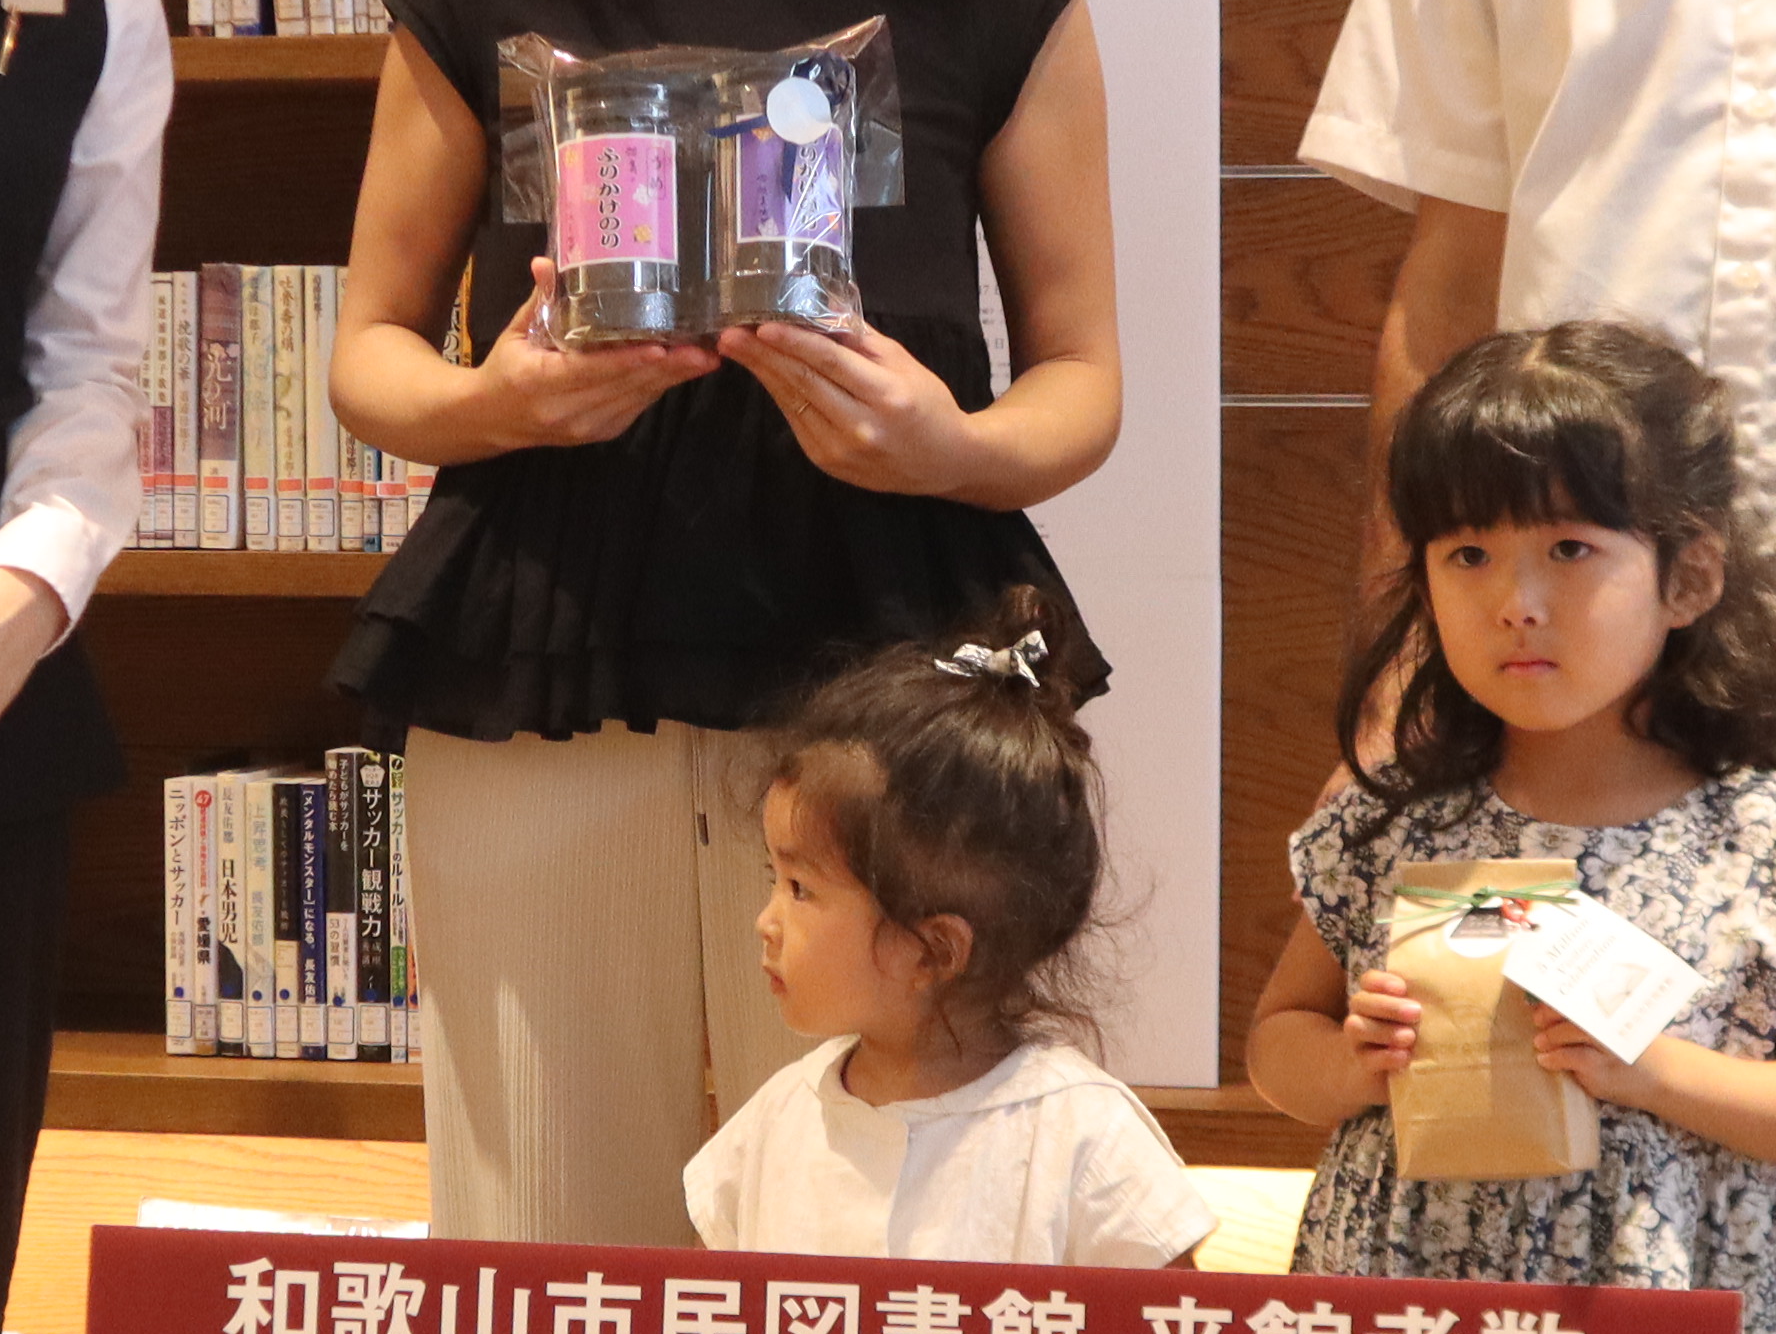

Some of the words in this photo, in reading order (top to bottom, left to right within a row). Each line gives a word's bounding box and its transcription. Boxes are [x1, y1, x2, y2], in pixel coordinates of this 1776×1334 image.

[597, 147, 620, 248] ふりかけのり
[169, 788, 187, 927] ニッポンとサッカー
[221, 858, 238, 945] 日本男児
[361, 789, 384, 937] サッカー観戦力
[391, 791, 404, 907] サッカーのルール
[196, 916, 212, 965] 愛媛県
